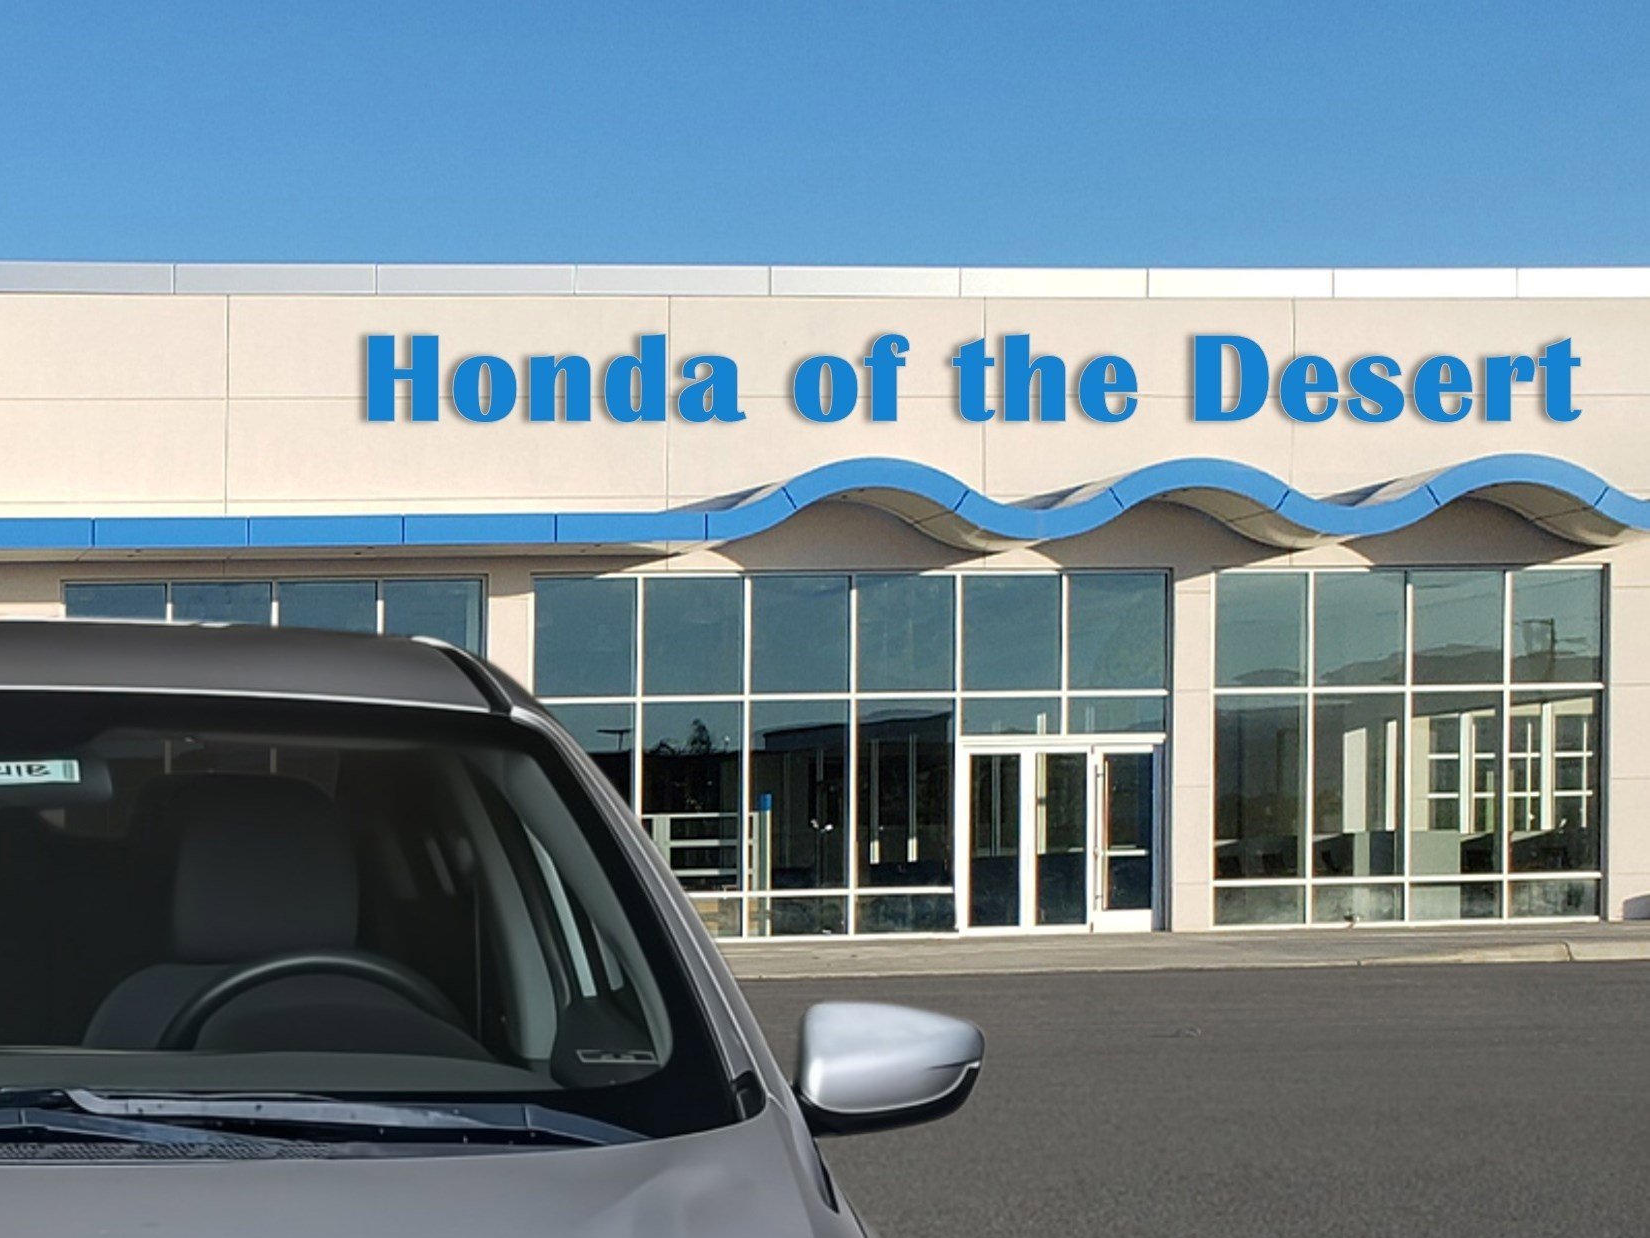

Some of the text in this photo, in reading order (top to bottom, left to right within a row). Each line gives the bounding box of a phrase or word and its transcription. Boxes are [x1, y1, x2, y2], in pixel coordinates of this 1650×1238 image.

[365, 332, 1582, 423] Honda of the Desert
